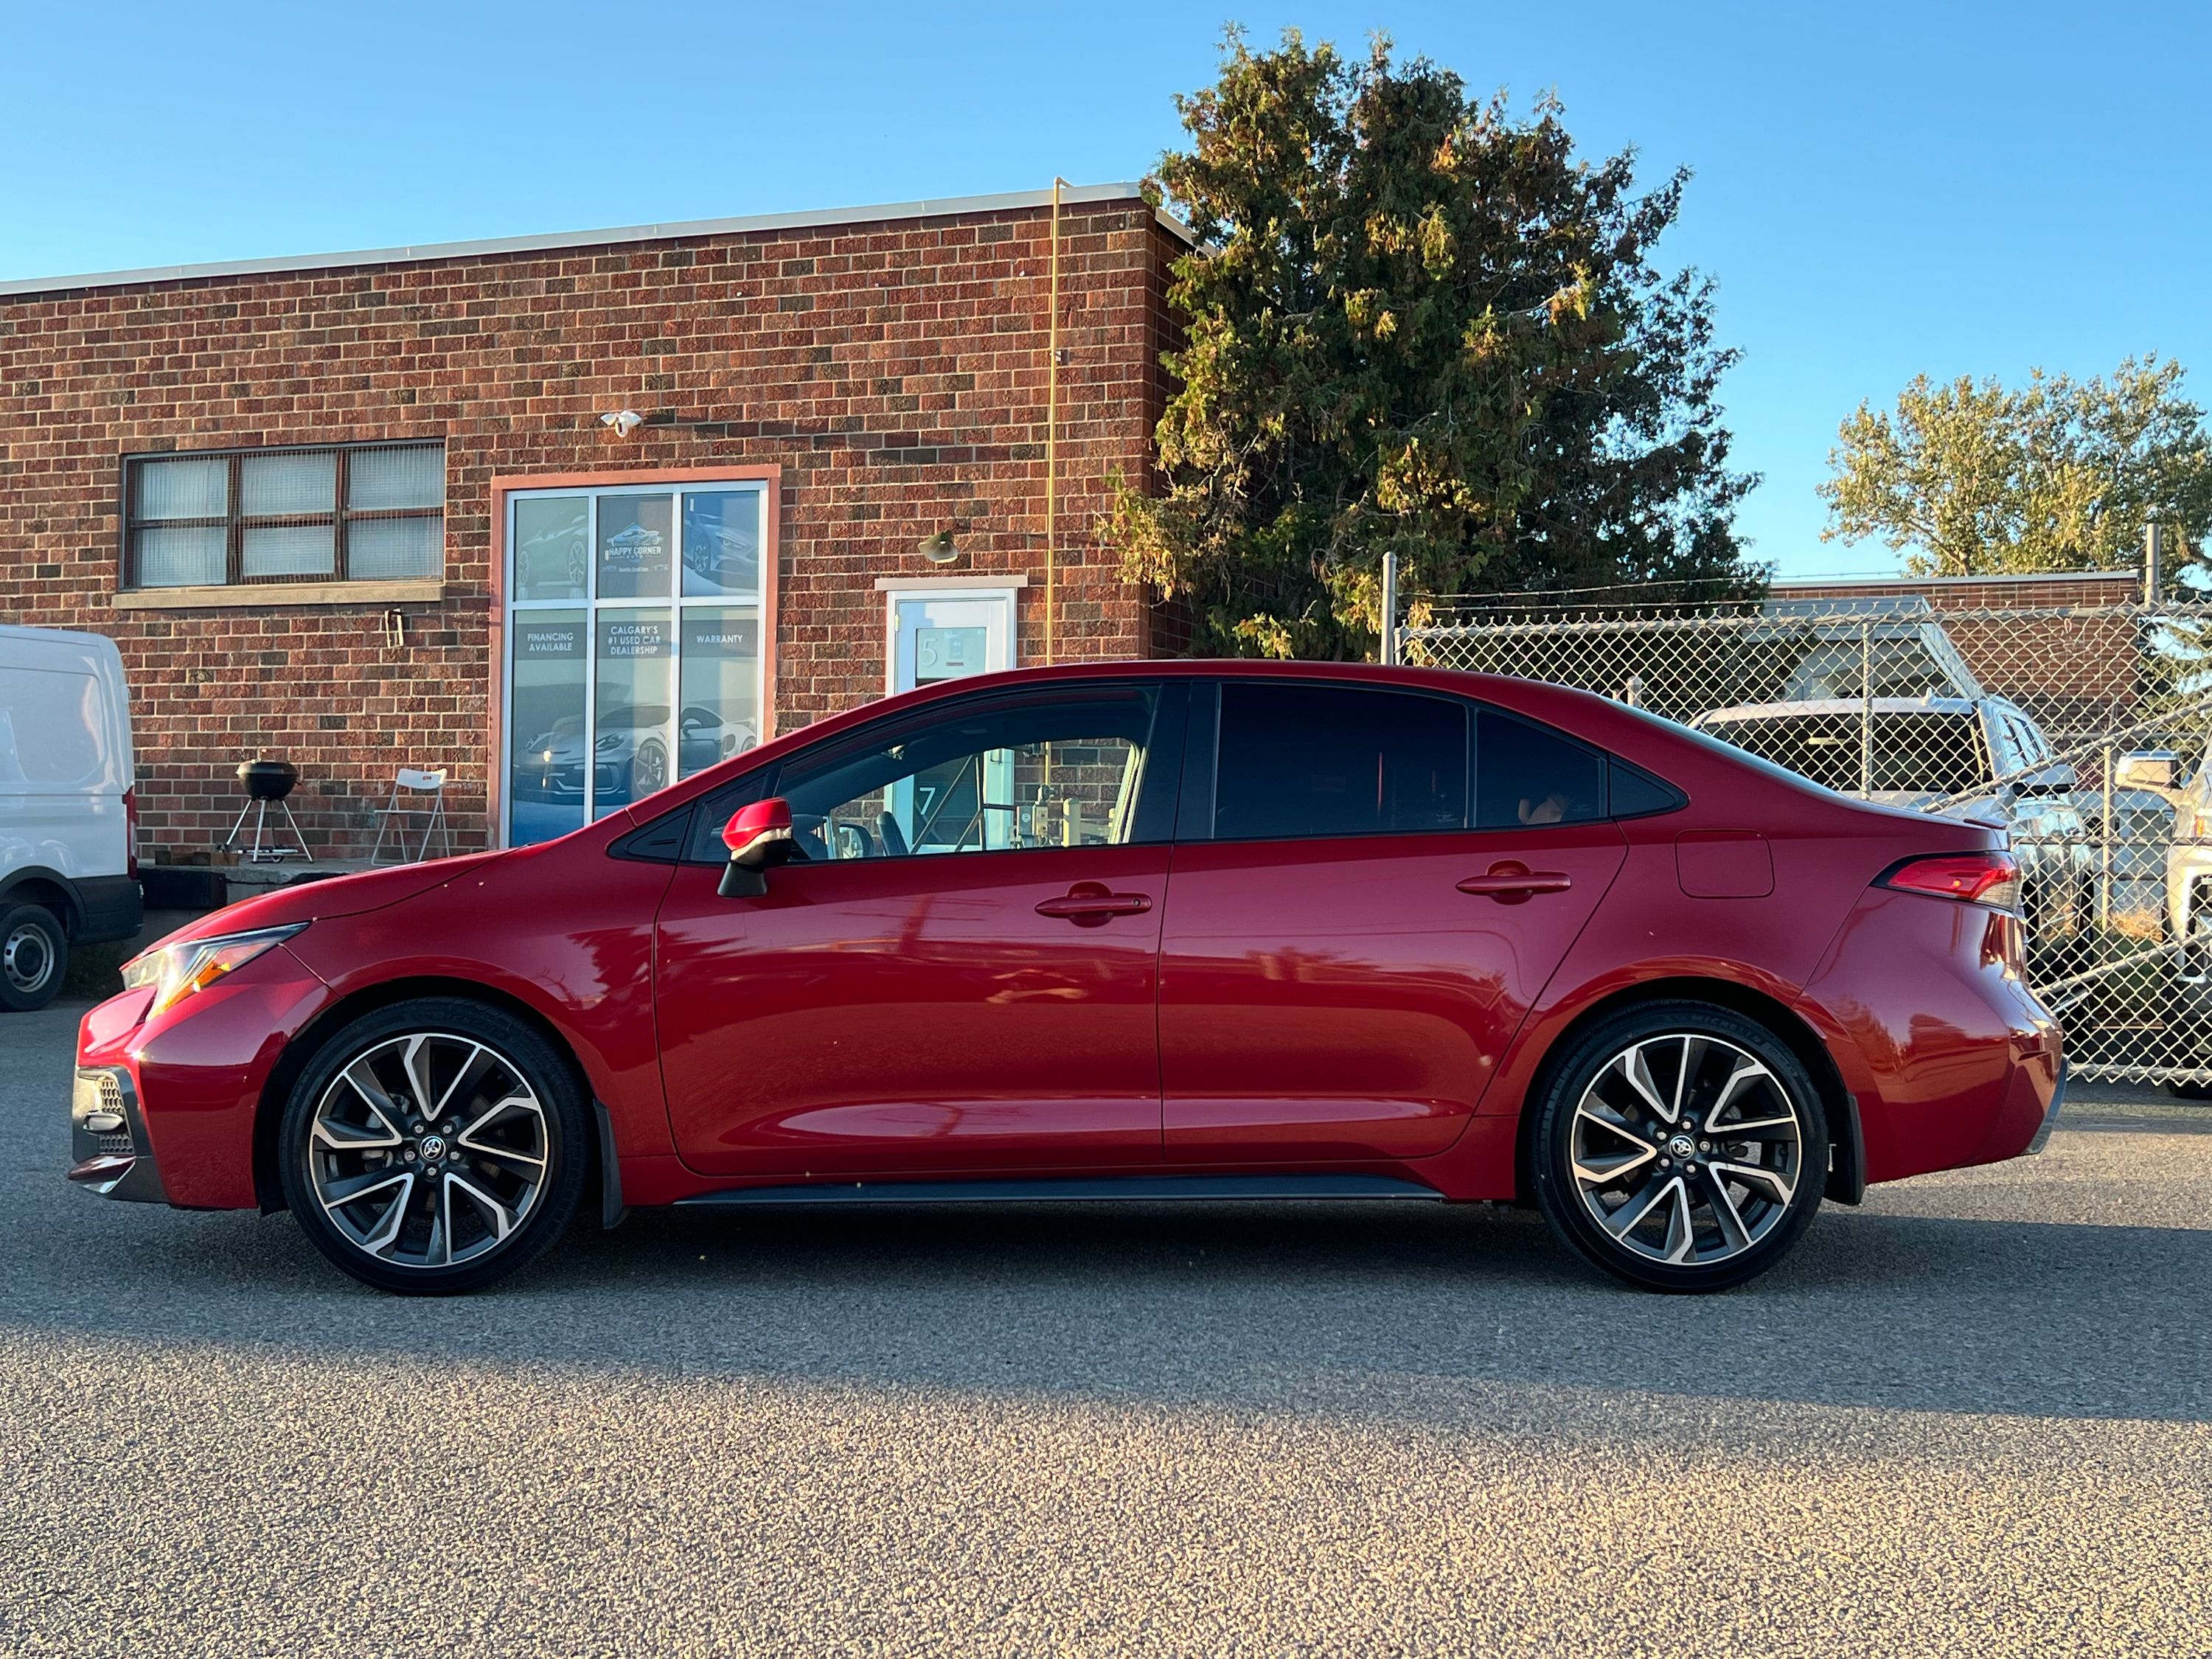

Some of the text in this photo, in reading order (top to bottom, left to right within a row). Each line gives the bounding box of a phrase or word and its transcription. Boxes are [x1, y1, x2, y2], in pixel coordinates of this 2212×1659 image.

[609, 546, 662, 556] HAPPY CORNER
[611, 625, 658, 635] CALGARY'S
[527, 632, 574, 642] FINANCING
[608, 636, 661, 645] #1 USED CAR
[696, 634, 743, 644] WARRANTY
[529, 642, 573, 652] AVAILABLE
[611, 645, 658, 655] DEALERSHIP
[922, 637, 938, 666] 5
[919, 787, 936, 815] 7
